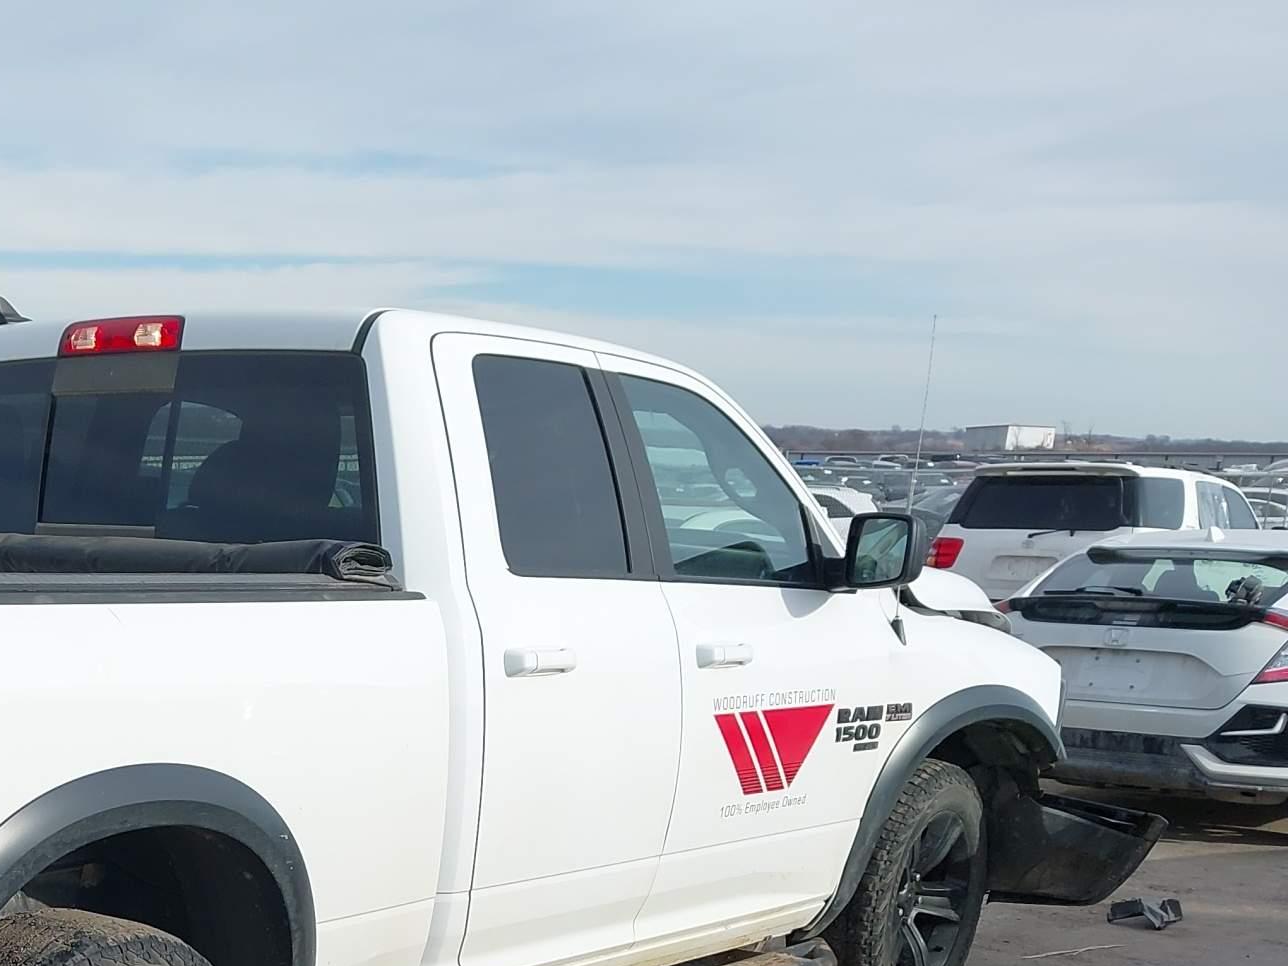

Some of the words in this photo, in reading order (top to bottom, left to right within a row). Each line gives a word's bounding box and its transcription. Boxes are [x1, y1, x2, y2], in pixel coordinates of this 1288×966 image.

[713, 693, 765, 711] WOODRUFF
[769, 688, 836, 706] CONSTRUCTION
[835, 723, 881, 743] 1500
[720, 803, 743, 818] 100%
[745, 799, 780, 815] Employee
[782, 793, 807, 808] Owned
